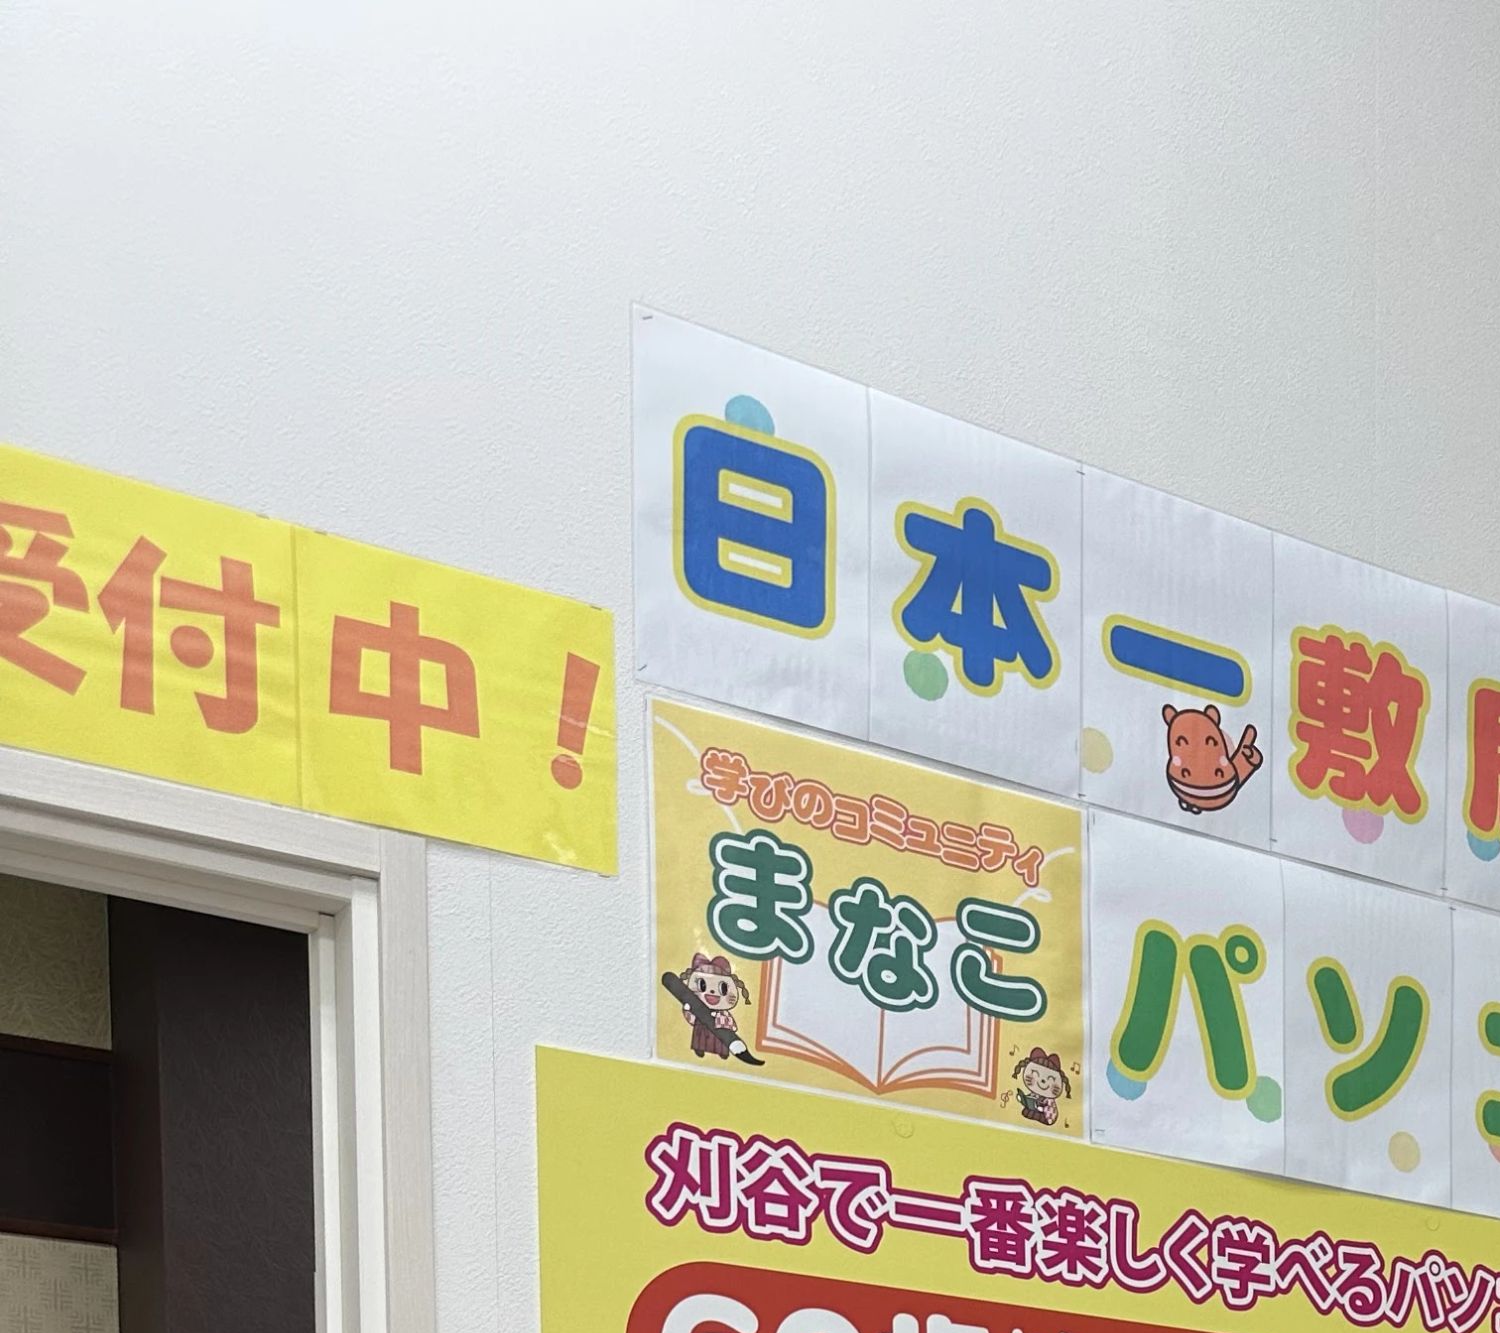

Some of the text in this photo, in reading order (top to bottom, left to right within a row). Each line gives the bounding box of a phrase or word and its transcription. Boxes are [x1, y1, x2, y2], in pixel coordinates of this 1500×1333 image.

[700, 748, 1044, 888] 学びのコミュニティ
[707, 831, 1048, 1020] まなこ
